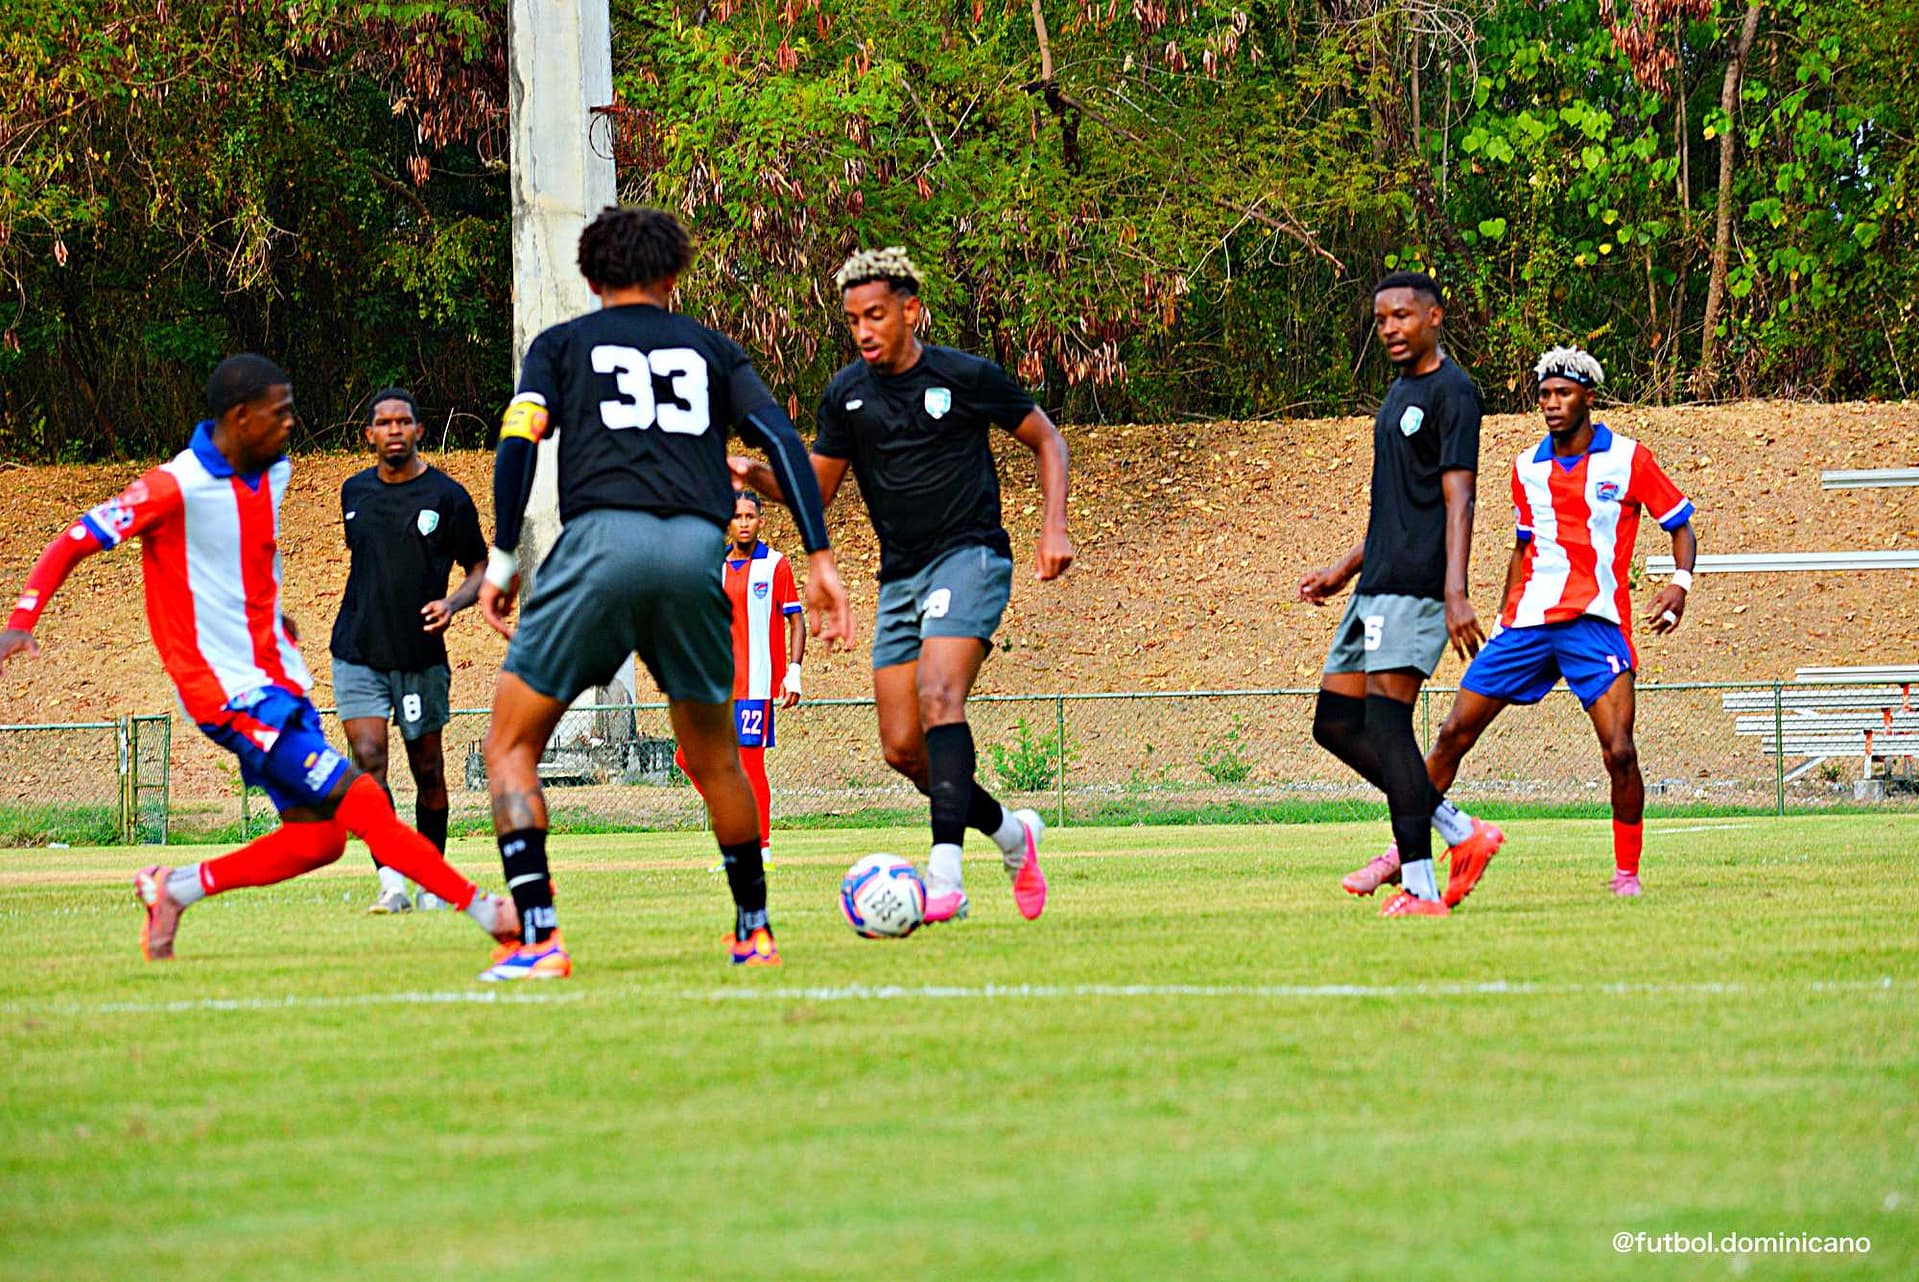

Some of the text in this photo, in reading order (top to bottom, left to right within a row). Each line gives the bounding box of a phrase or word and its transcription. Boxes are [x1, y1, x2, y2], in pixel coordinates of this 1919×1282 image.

[590, 344, 710, 437] 33
[1364, 614, 1385, 651] 5
[402, 693, 422, 722] 8
[741, 709, 762, 735] 22
